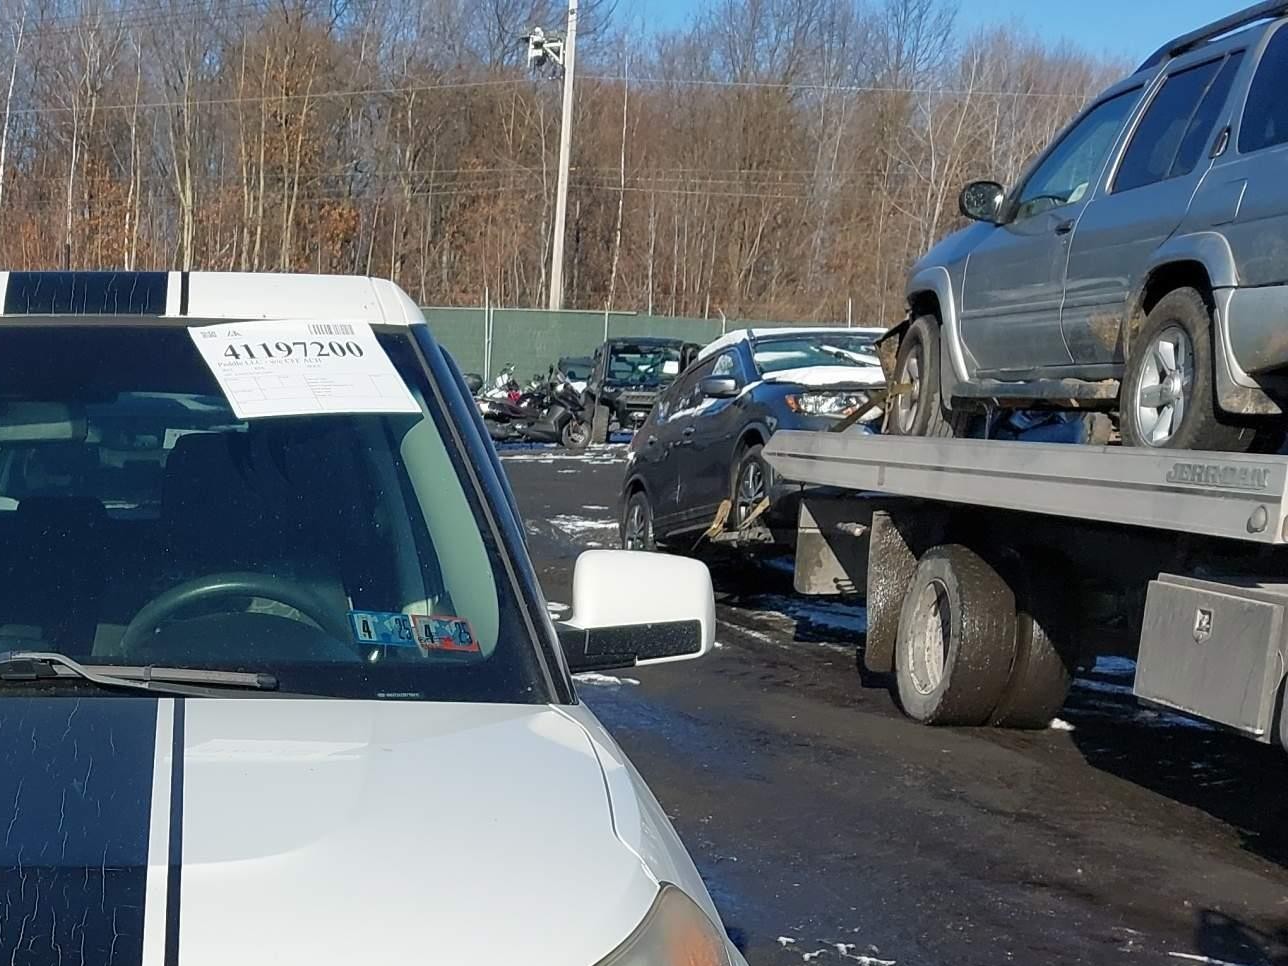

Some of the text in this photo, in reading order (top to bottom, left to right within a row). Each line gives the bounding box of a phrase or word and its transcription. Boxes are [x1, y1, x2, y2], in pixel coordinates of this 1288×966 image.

[223, 341, 364, 360] 41197200
[362, 618, 413, 640] 4 25
[424, 624, 435, 644] 4
